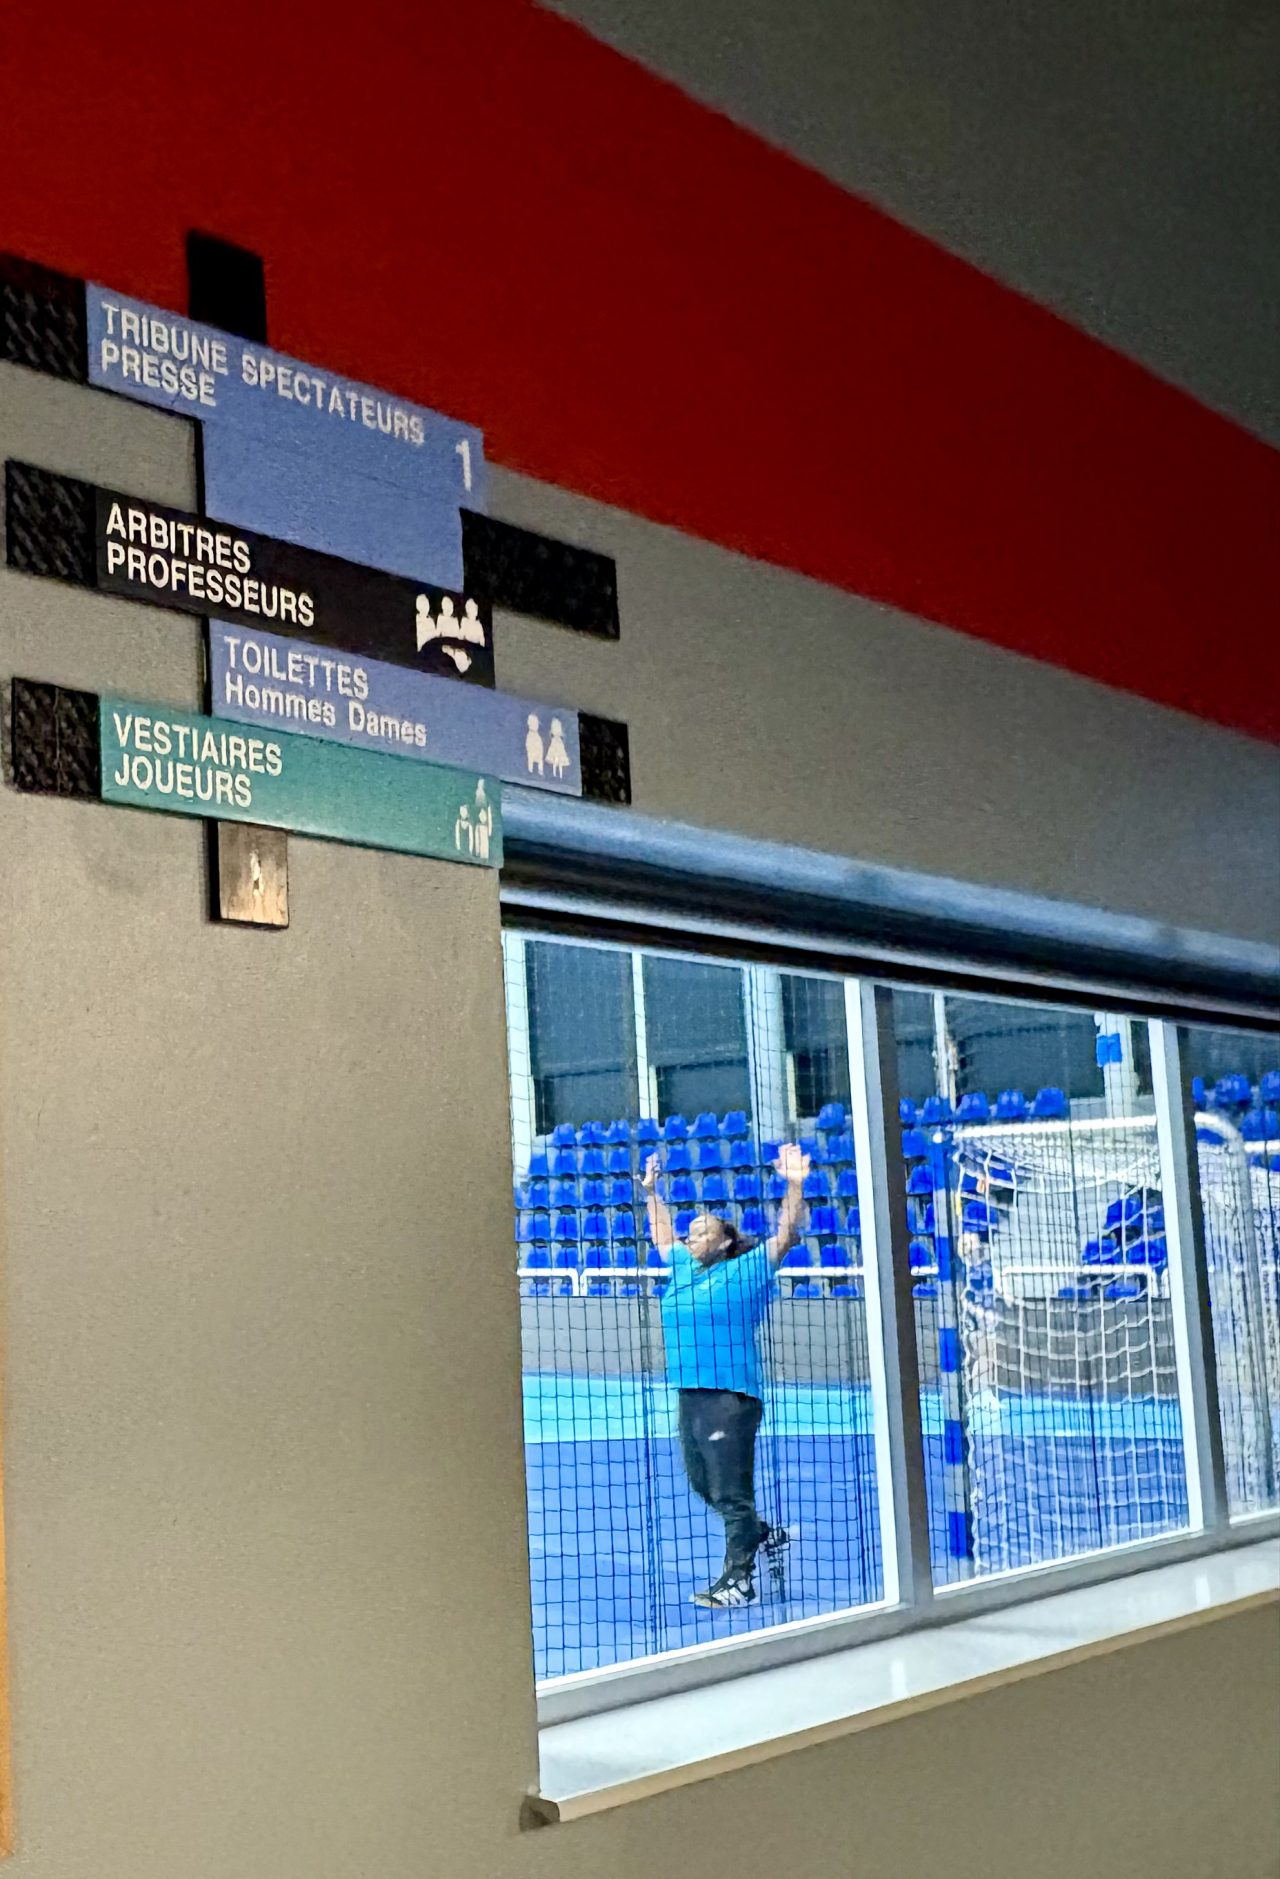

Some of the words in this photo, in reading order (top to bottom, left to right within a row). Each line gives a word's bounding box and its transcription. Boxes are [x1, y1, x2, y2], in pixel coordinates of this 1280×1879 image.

[101, 339, 217, 407] PRESSE
[101, 301, 228, 375] TRIBUNE
[241, 352, 425, 446] SPECTATEURS
[455, 439, 472, 492] 1
[106, 503, 252, 574] ARBITRES
[107, 541, 315, 627] PROFESSEURS
[224, 636, 369, 700] TOILETTES
[225, 671, 336, 727] Hommes
[348, 701, 427, 747] Dames
[113, 712, 283, 776] VESTIAIRES
[114, 753, 252, 807] JOUEURS
